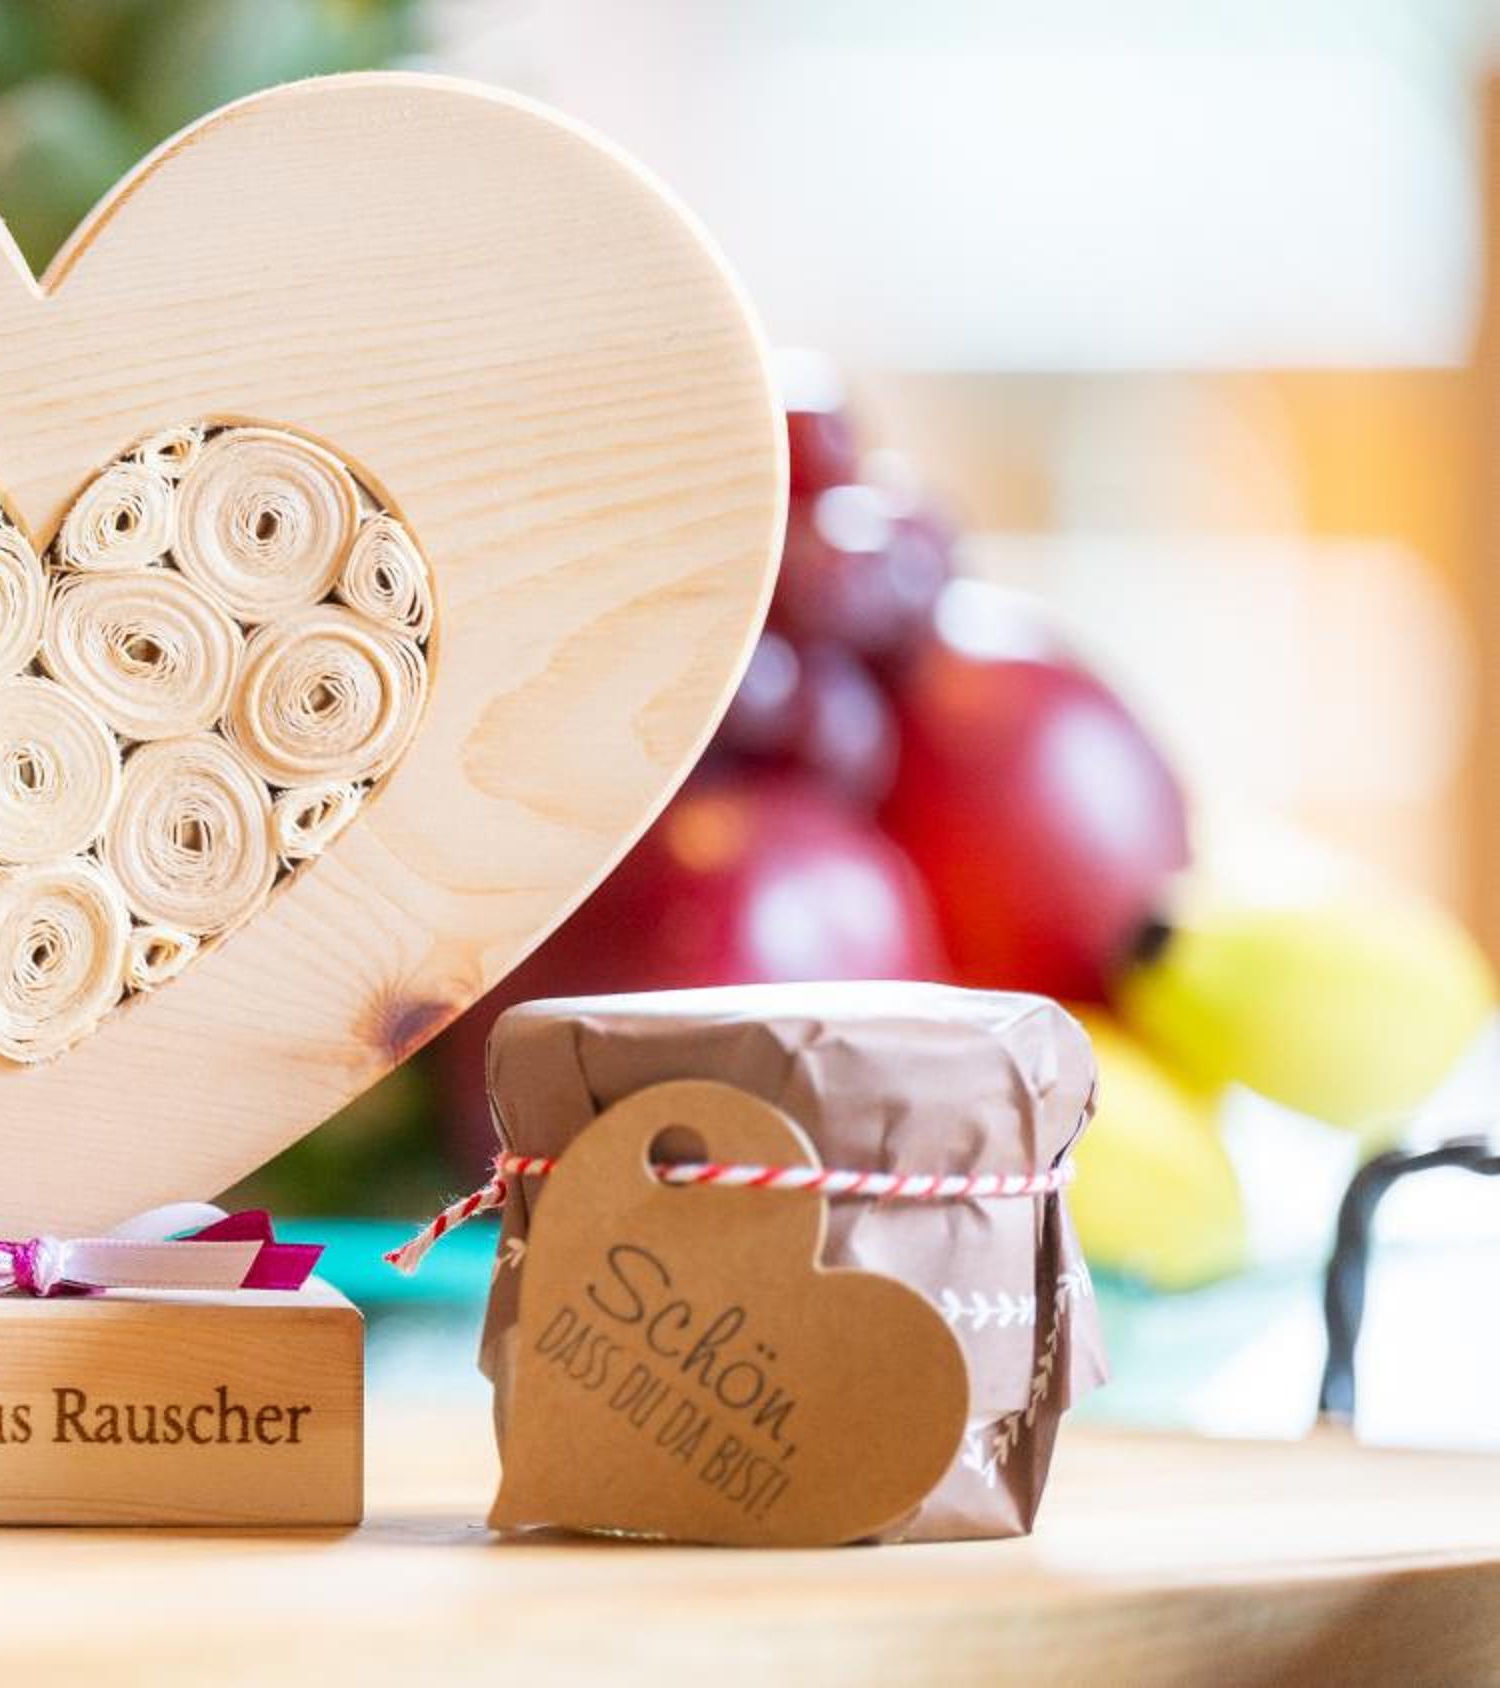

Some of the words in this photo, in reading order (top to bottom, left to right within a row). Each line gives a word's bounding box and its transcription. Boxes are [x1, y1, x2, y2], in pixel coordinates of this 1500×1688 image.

[51, 1385, 312, 1445] Rauscher
[534, 1307, 618, 1390] DASS
[609, 1363, 671, 1430] DU
[655, 1399, 710, 1464] DA
[700, 1435, 791, 1522] BIST!
[586, 1244, 796, 1461] Schön,
